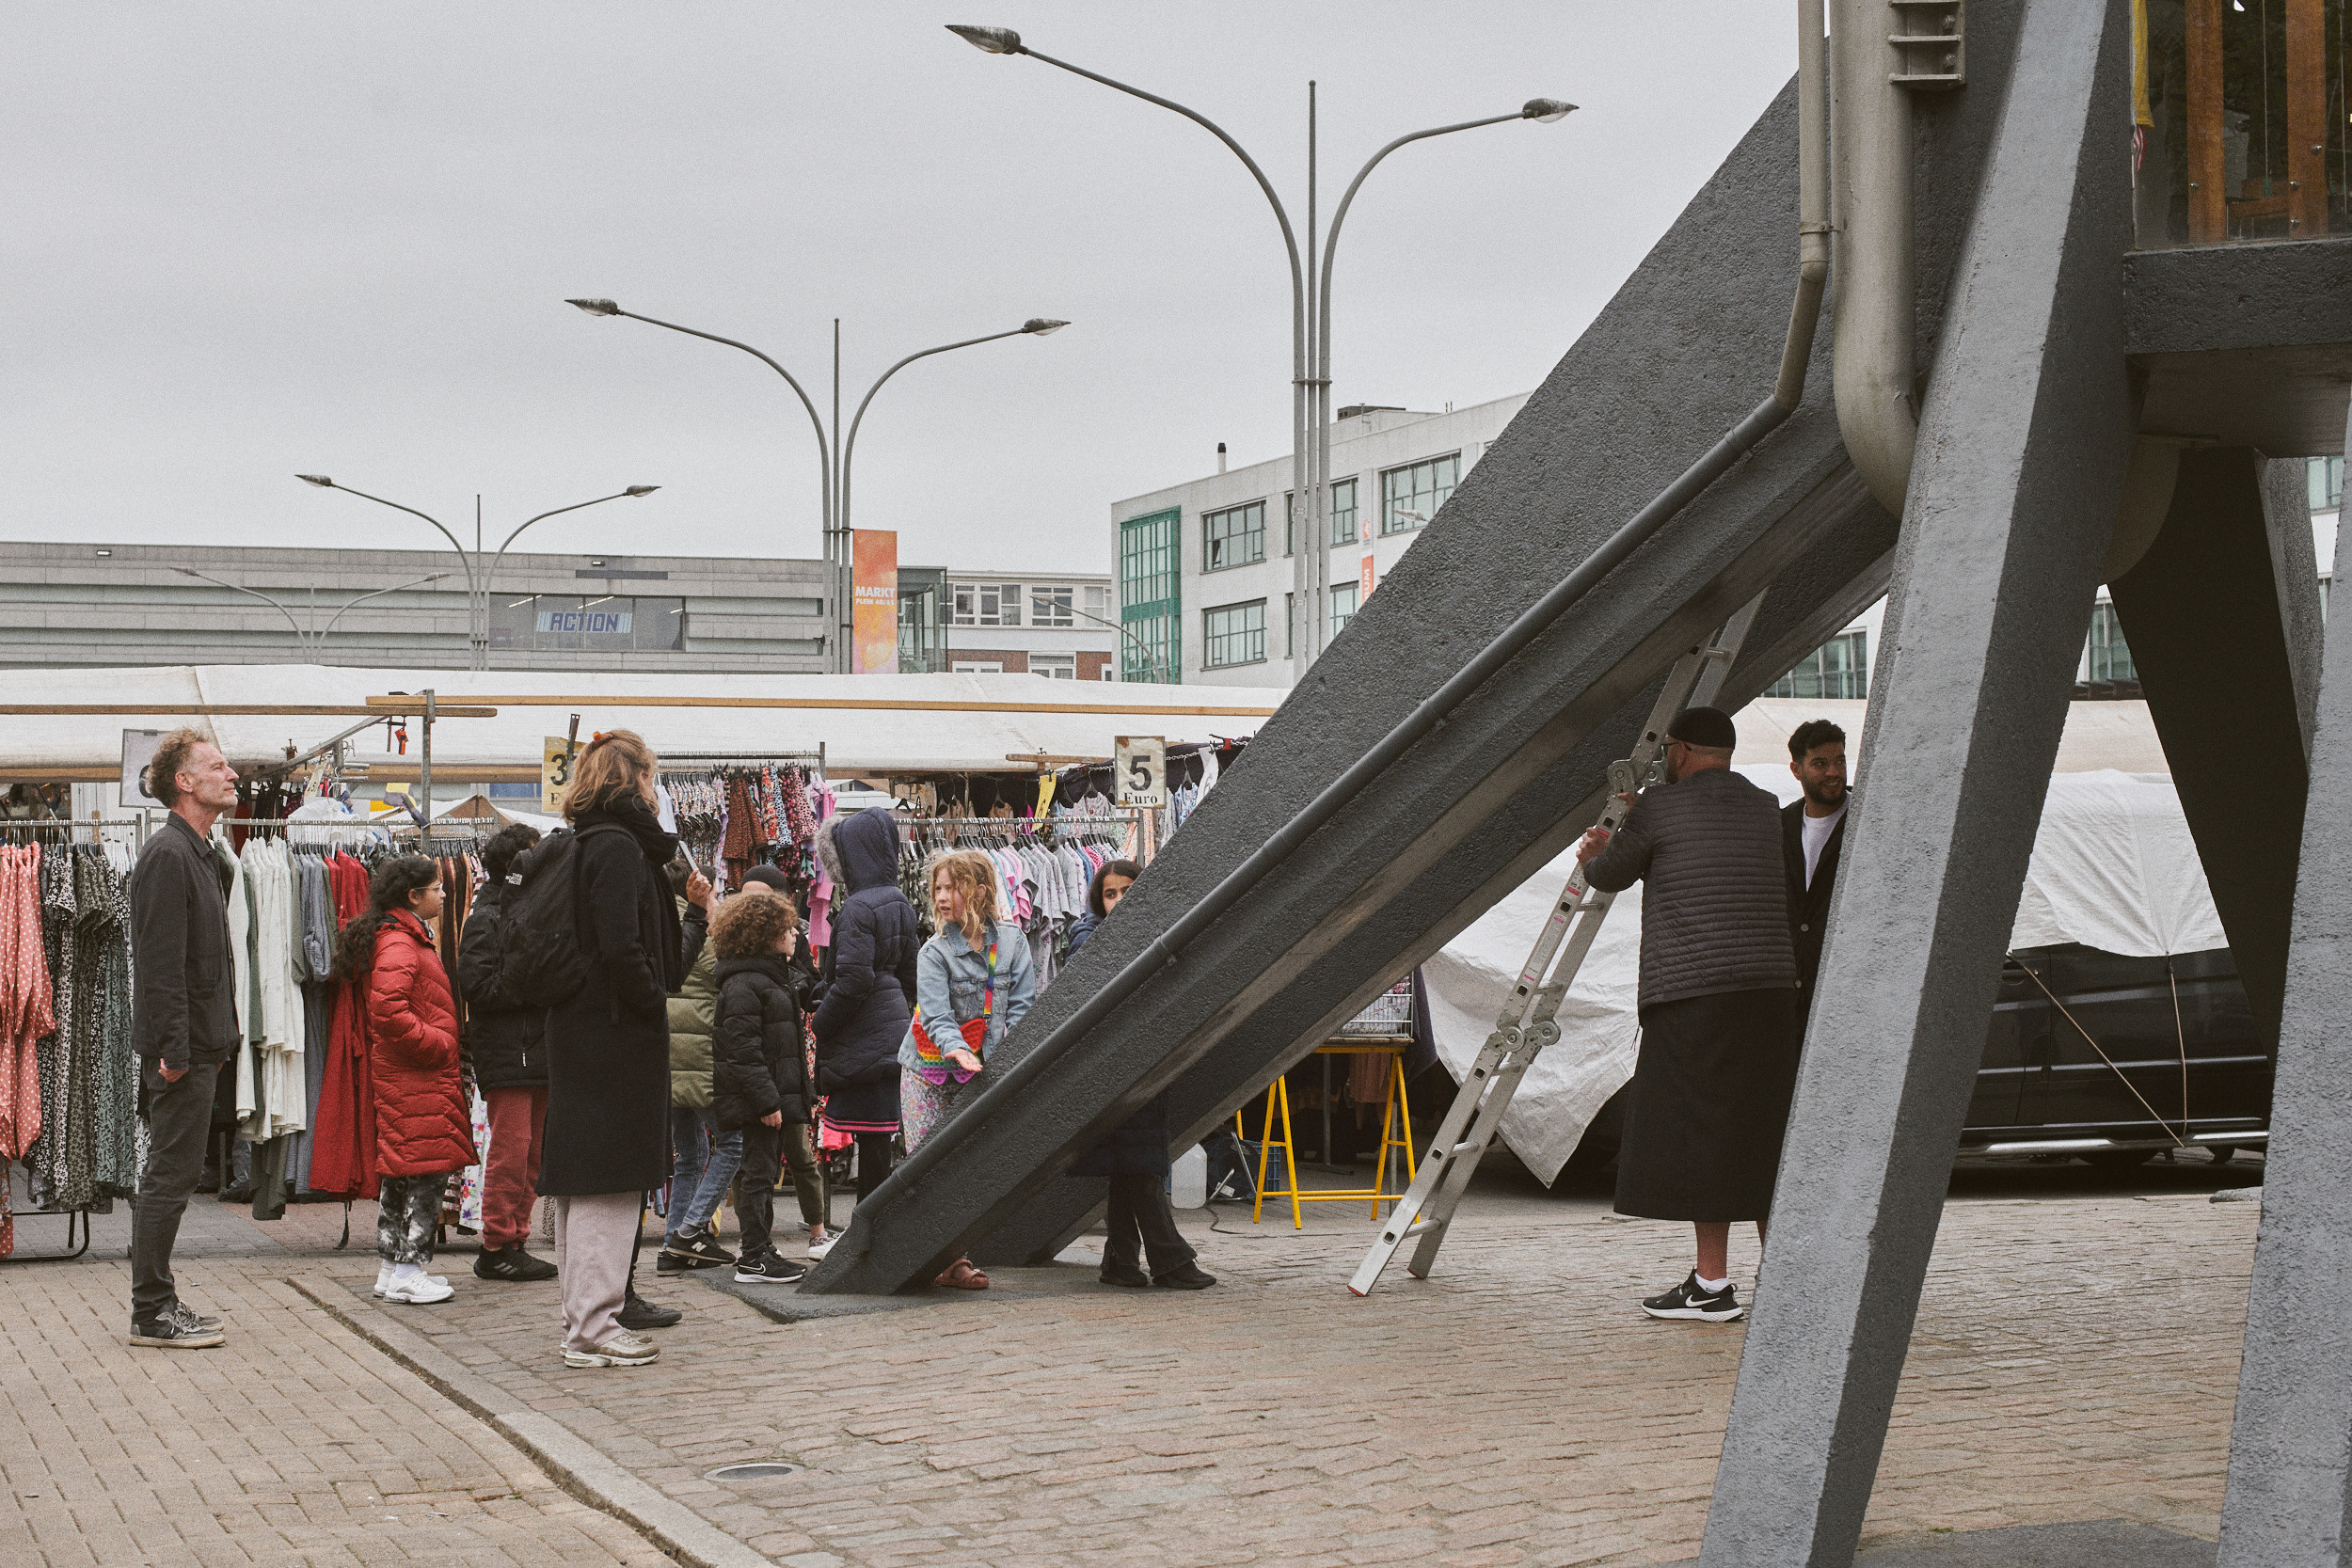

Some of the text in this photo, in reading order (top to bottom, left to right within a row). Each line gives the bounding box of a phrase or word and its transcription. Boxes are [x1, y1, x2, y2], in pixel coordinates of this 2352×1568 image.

[855, 586, 896, 598] MARKT
[549, 612, 620, 632] ACTION
[550, 753, 568, 786] 3
[1128, 755, 1152, 792] 5
[1123, 792, 1158, 804] Euro
